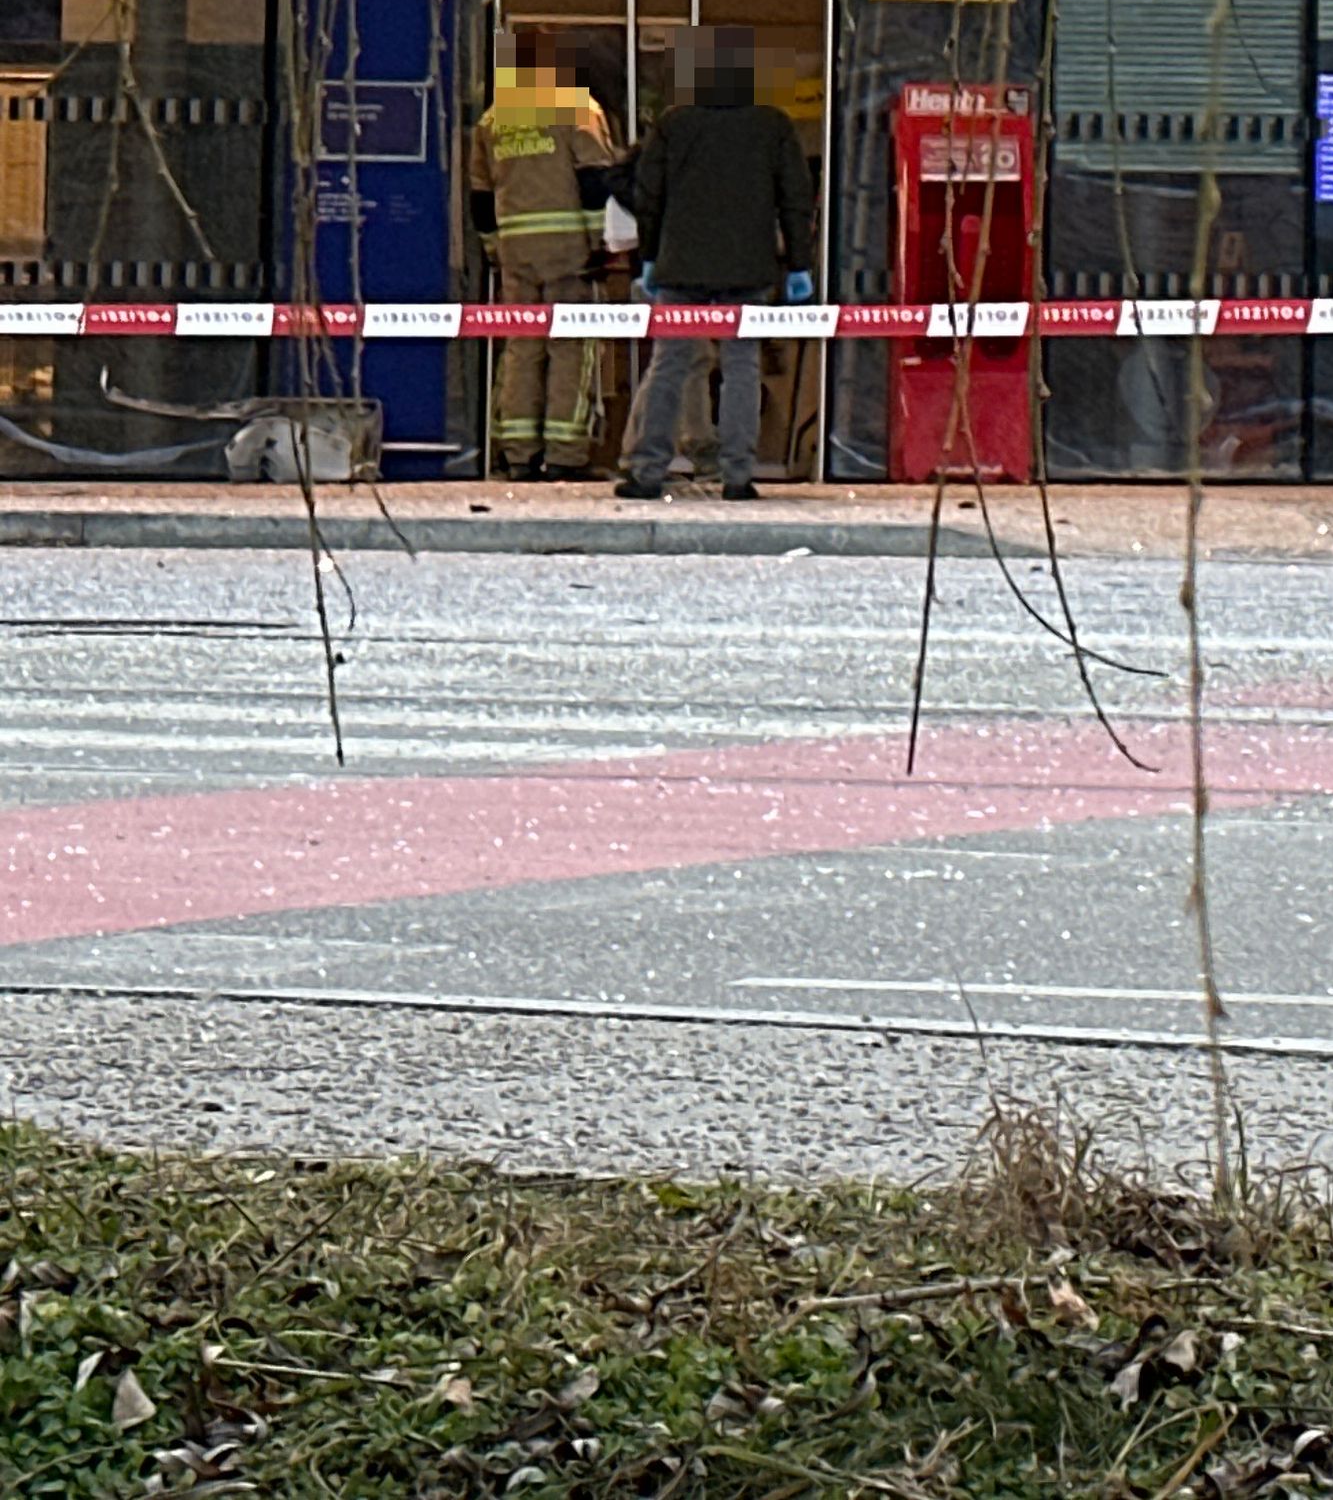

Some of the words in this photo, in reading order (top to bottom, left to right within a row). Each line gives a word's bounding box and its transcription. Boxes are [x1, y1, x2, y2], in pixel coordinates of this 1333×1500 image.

[102, 310, 172, 323] POLIZEI
[477, 310, 547, 323] POLIZEI
[665, 310, 736, 323] POLIZEI
[854, 309, 925, 322] POLIZEI
[1234, 306, 1305, 321] POLIZEI
